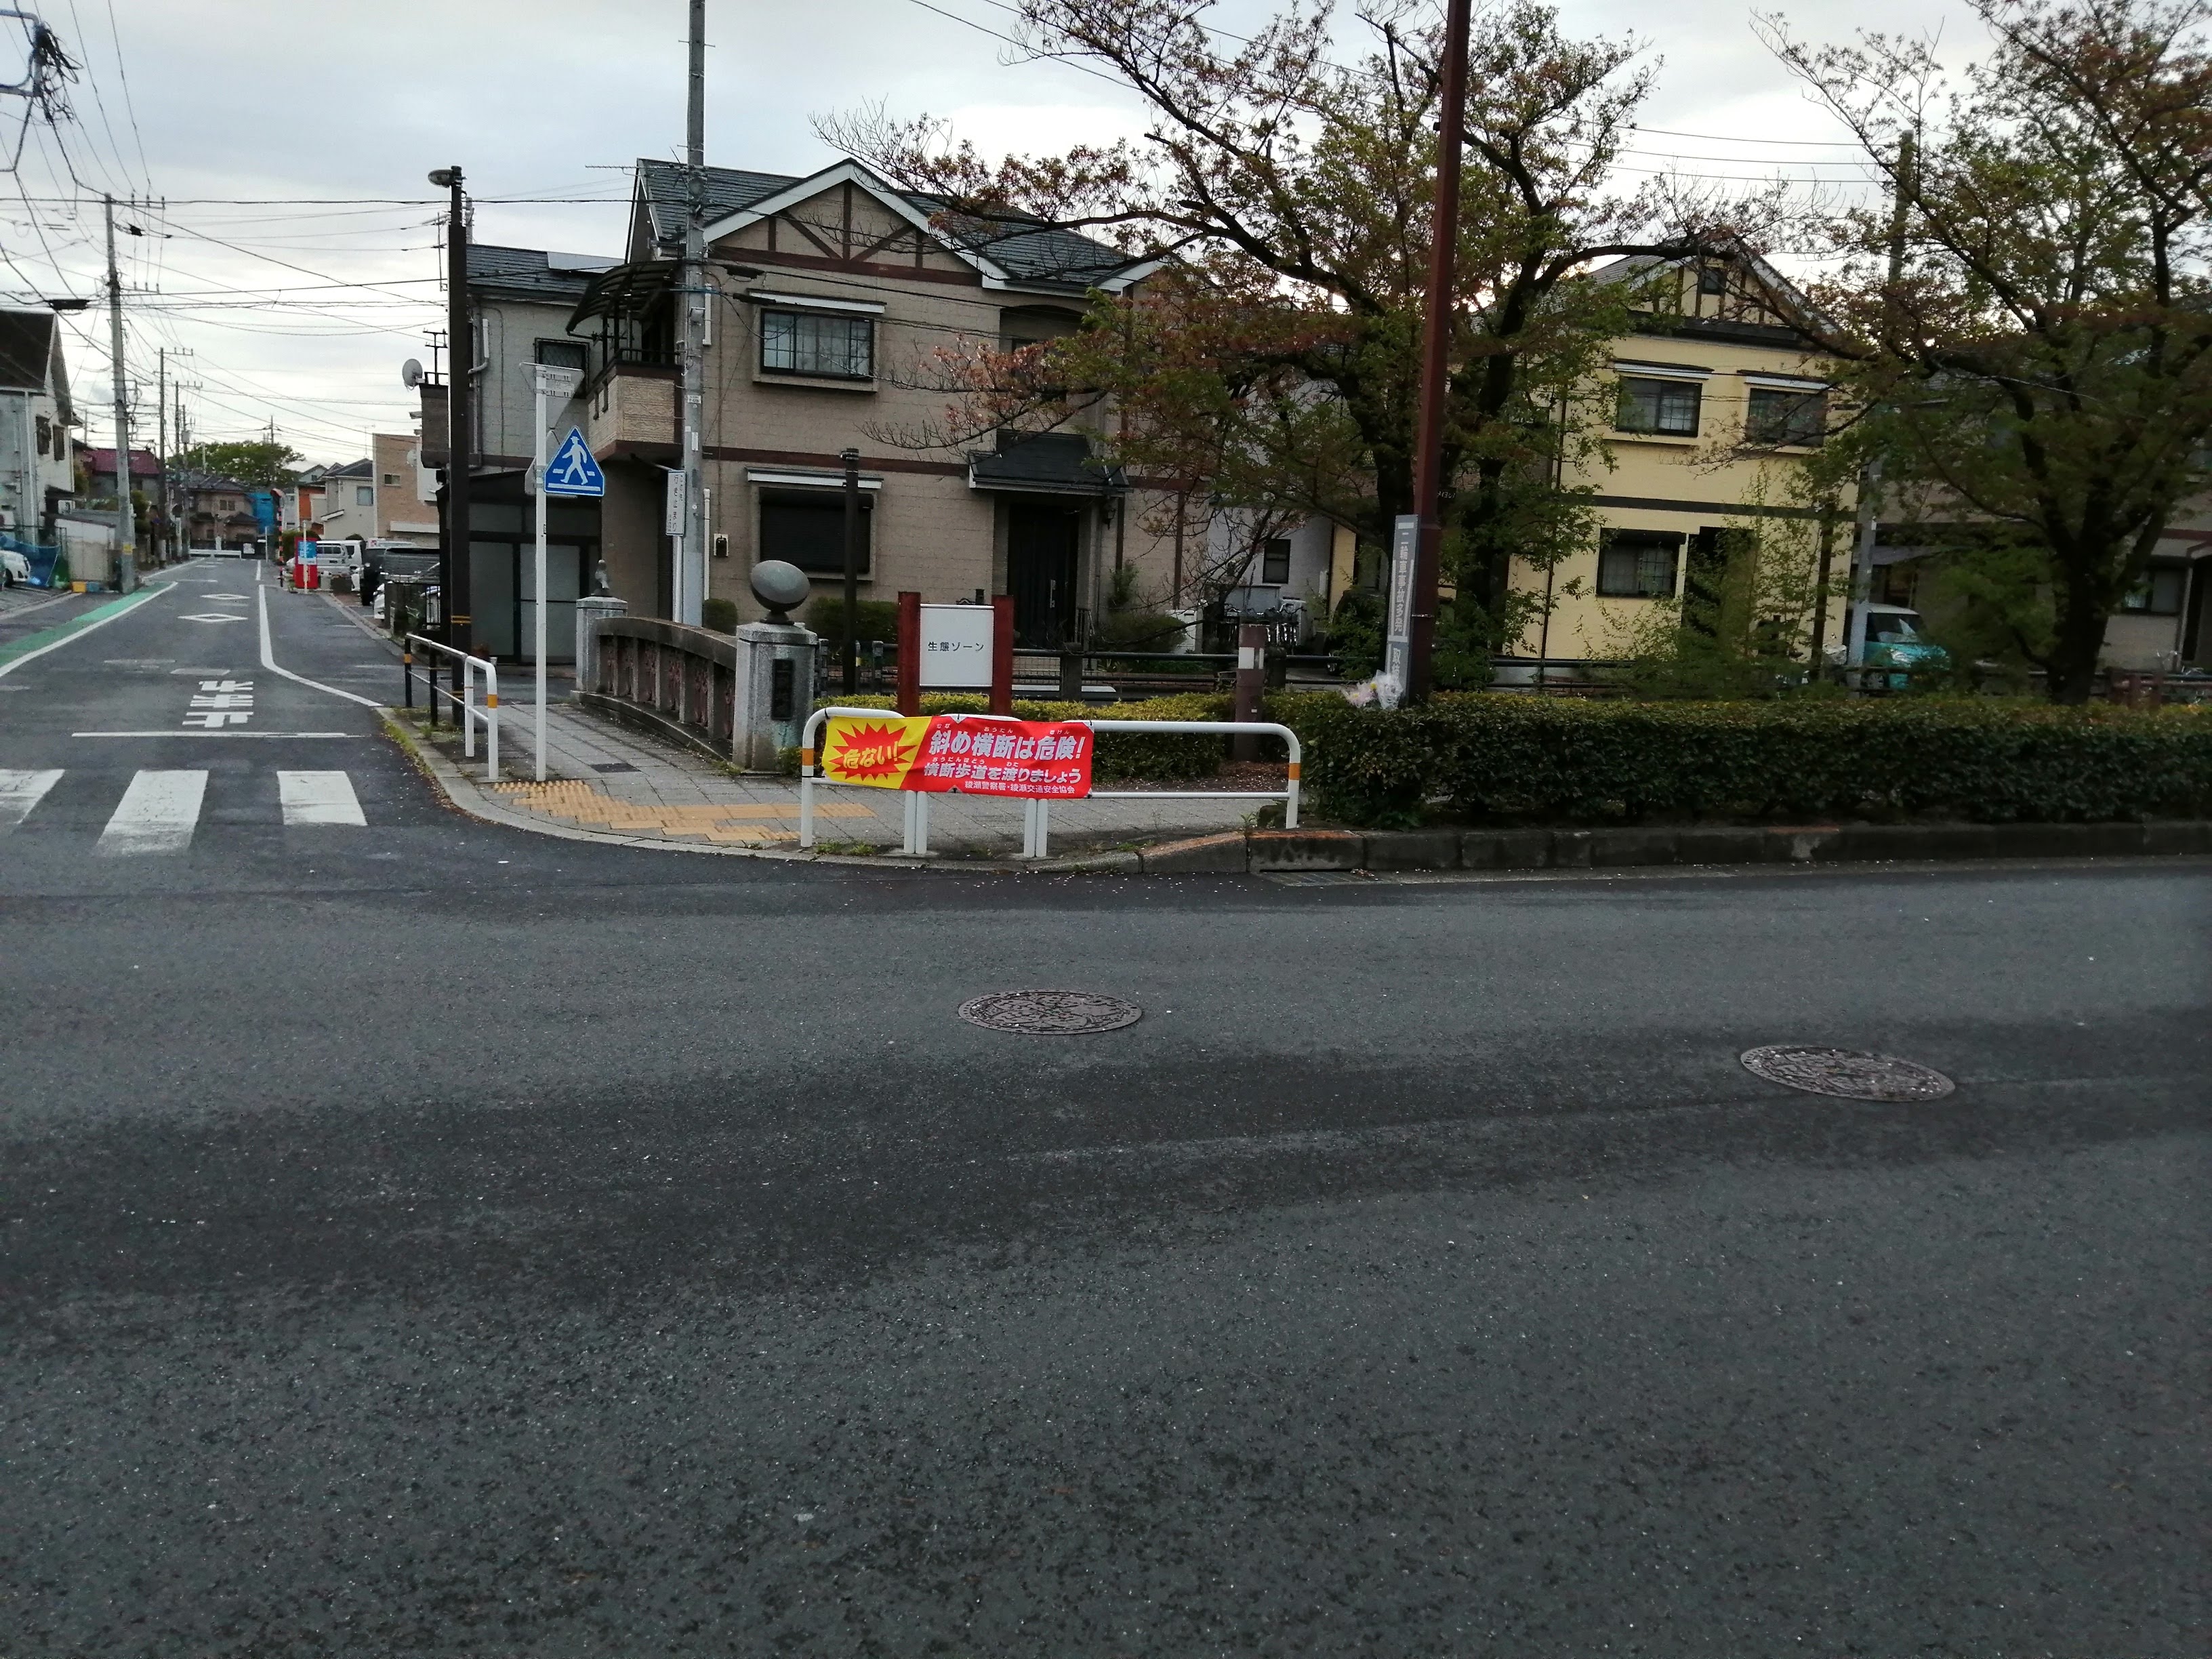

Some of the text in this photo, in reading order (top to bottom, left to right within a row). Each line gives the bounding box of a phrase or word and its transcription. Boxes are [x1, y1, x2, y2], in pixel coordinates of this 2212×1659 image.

[1394, 532, 1409, 632] 二輪車事故多発
[928, 641, 984, 652] 生態ゾーン
[182, 680, 254, 729] 止まれ
[843, 741, 899, 769] 危ない!
[928, 730, 1086, 760] 斜め横断は危険!
[924, 762, 1082, 784] 横断歩道を渡りましょう
[932, 756, 985, 764] おうだんほどう
